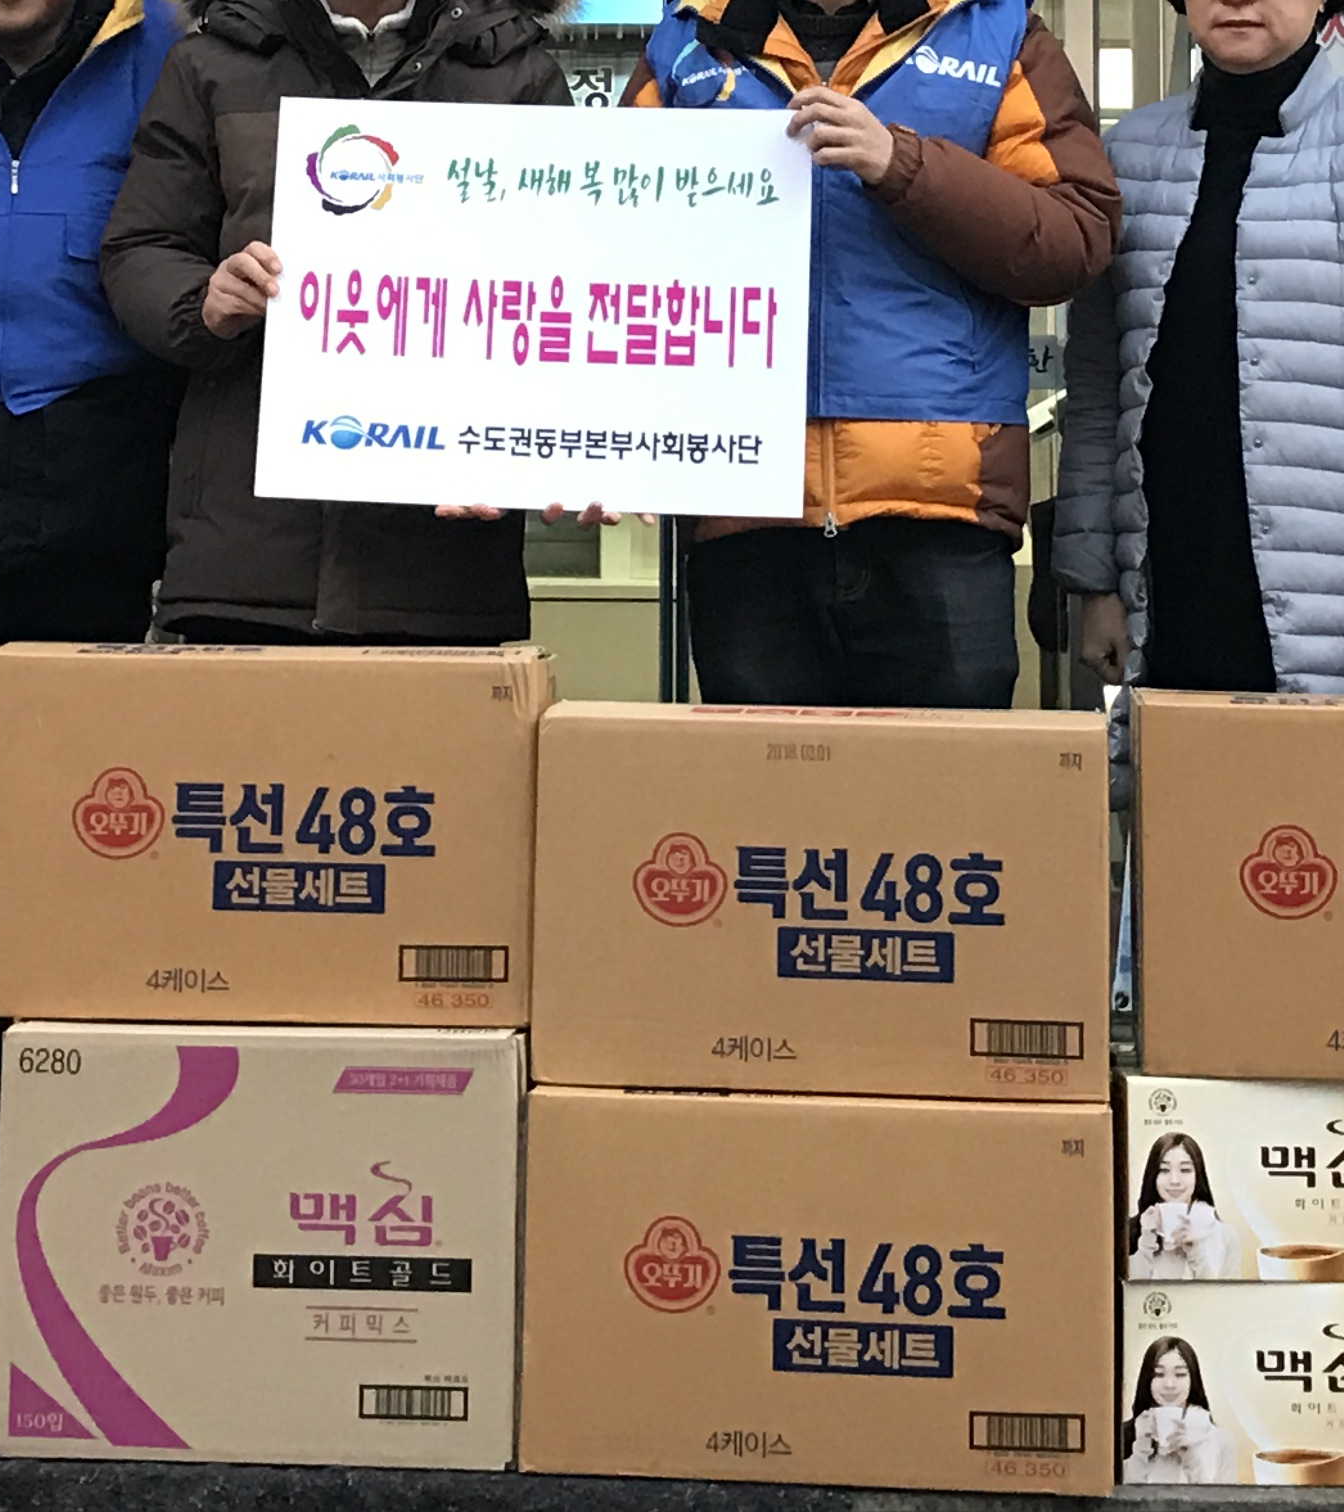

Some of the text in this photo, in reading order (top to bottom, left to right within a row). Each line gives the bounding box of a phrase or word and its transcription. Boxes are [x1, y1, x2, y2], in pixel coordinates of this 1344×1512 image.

[905, 46, 1001, 87] ORAIL
[446, 155, 780, 209] 설날, 새해 복 많이 받으세요
[299, 269, 778, 370] 이웃에게 사랑을 전달합니다
[301, 414, 763, 465] KORAIL 수도권동부본부사회봉사단
[89, 811, 148, 836] 오뚜기
[226, 869, 372, 906] 선물세트
[650, 876, 710, 902] 오뚜기
[1258, 870, 1319, 896] 오뚜기
[790, 935, 940, 974] 선물세트
[145, 968, 229, 992] 4케이스
[19, 1048, 82, 1075] 6280
[711, 1035, 797, 1061] 4케이스
[289, 1188, 433, 1247] 맥심
[272, 1258, 453, 1287] 화이트골드
[641, 1261, 703, 1289] 오뚜기
[198, 1287, 225, 1306] 커피
[312, 1313, 411, 1335] 커피믹스
[787, 1330, 939, 1369] 선물세트
[16, 1412, 64, 1432] 150입
[707, 1431, 792, 1456] 4케이스
